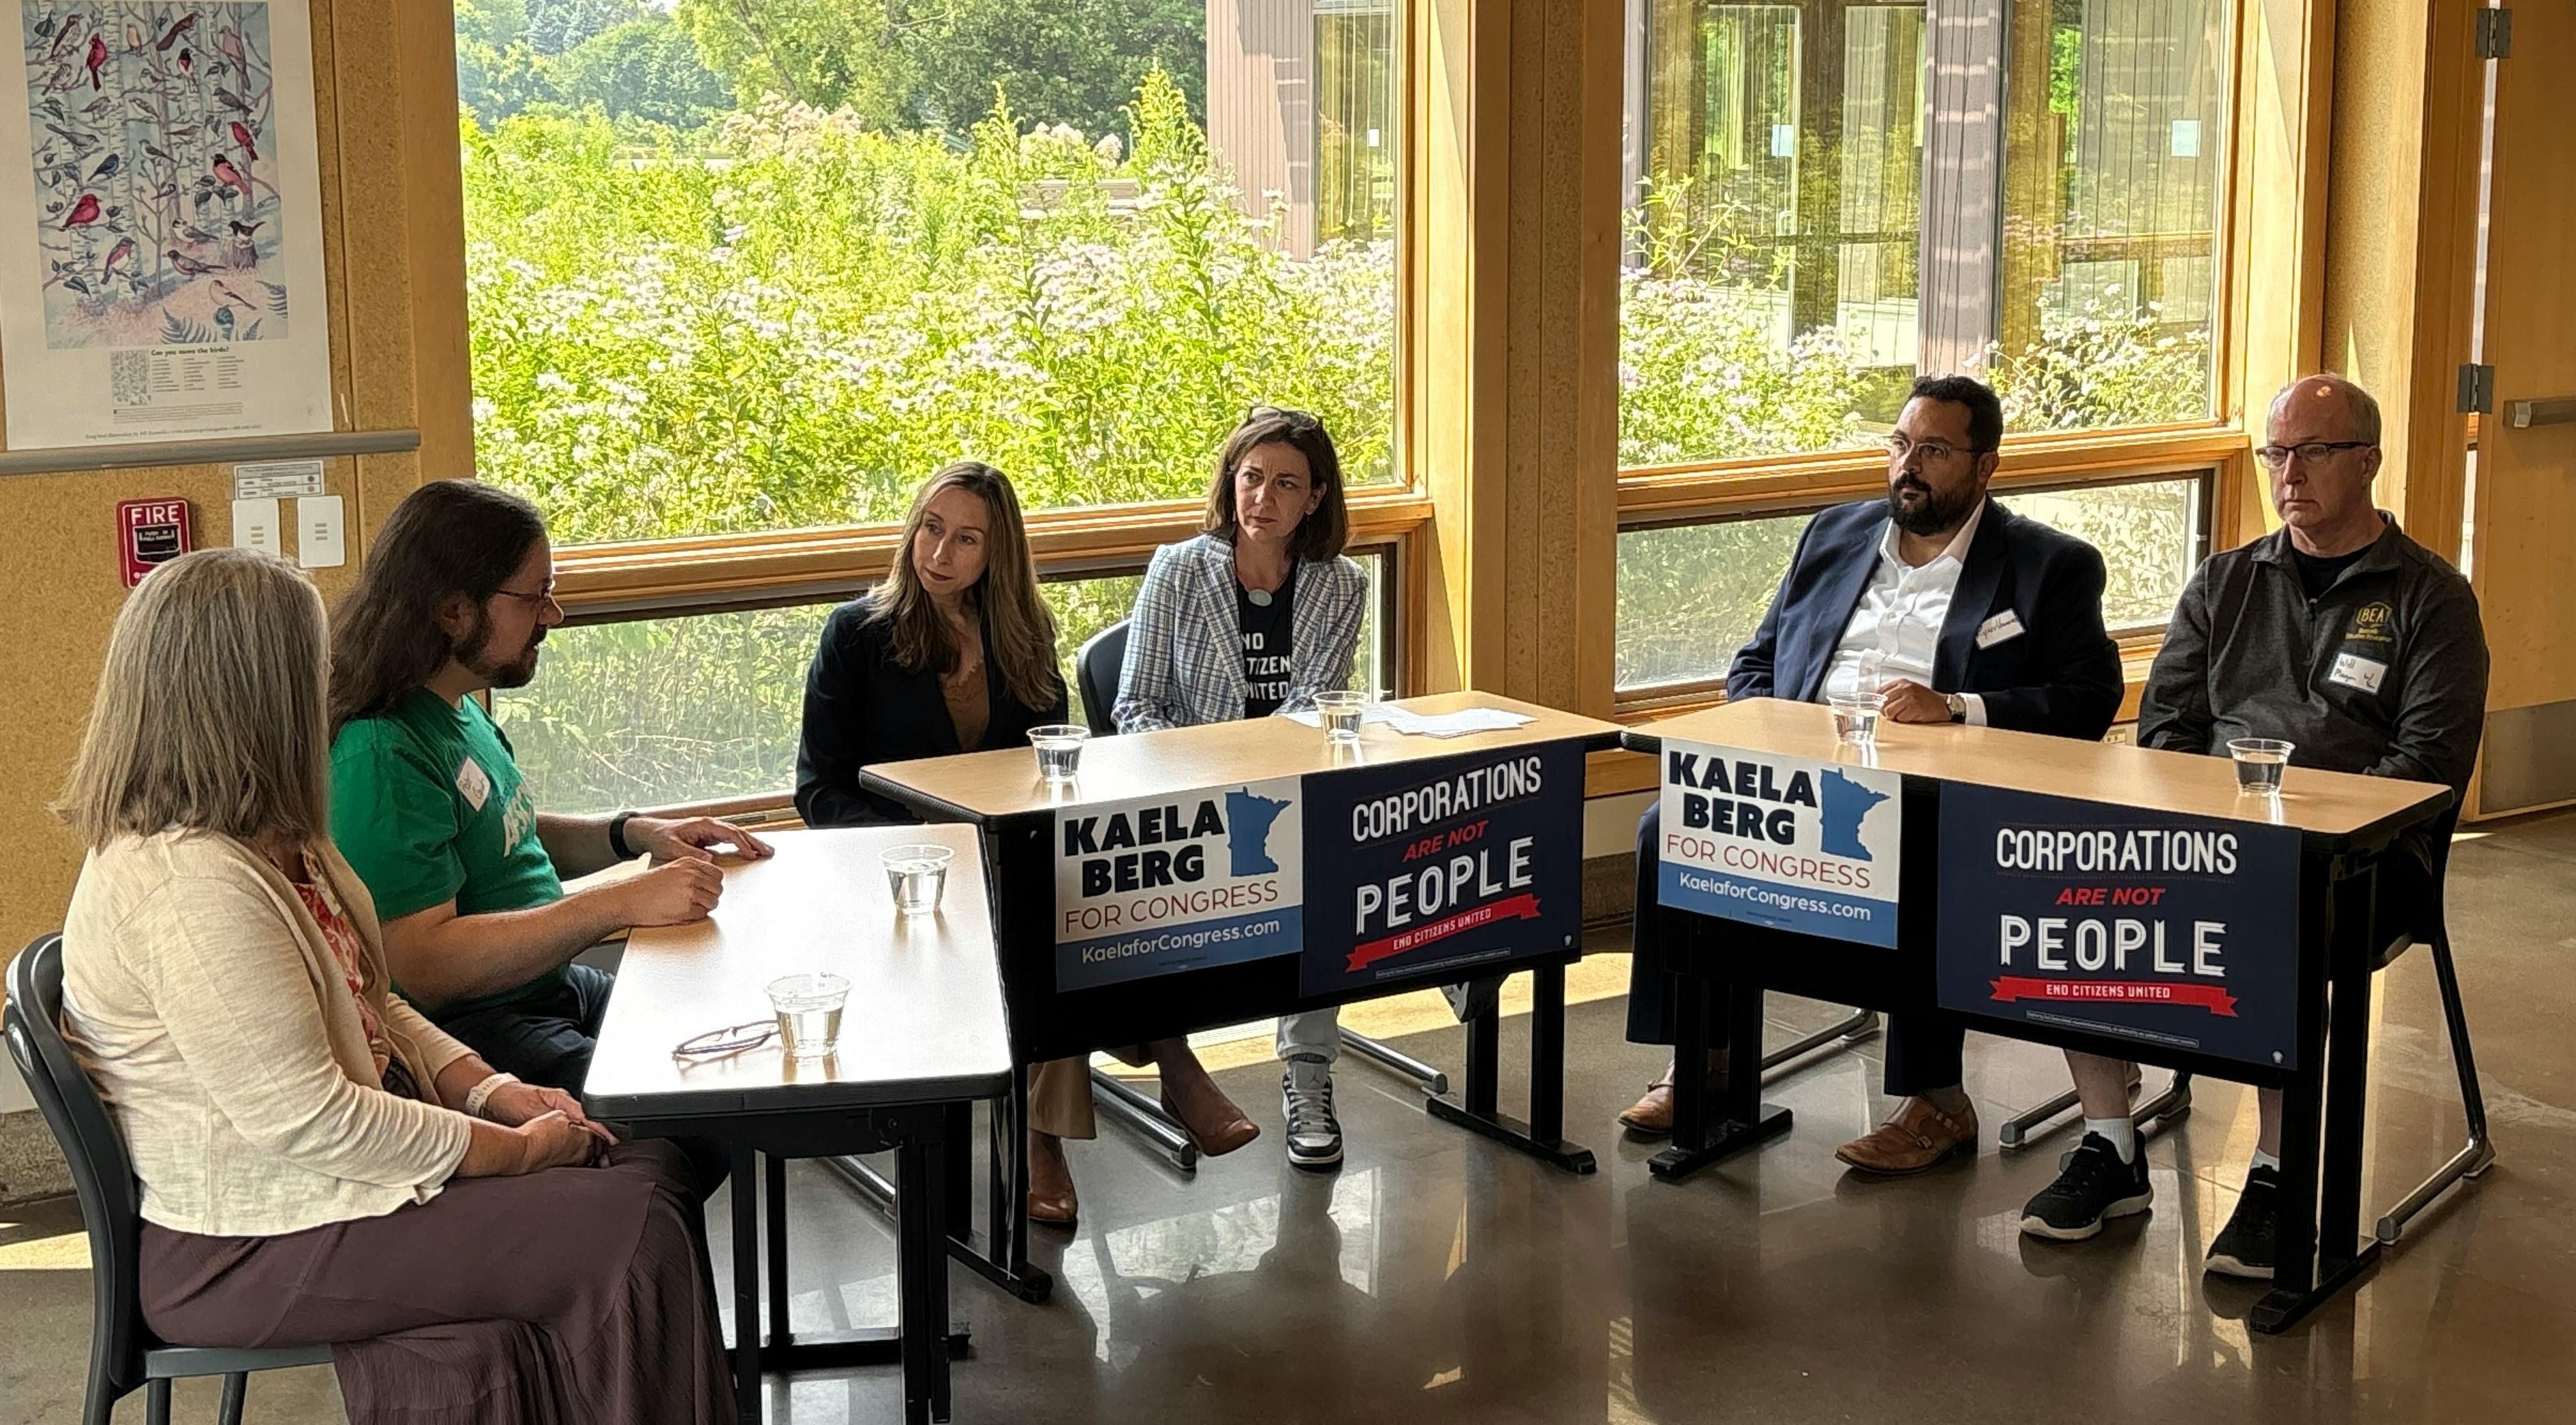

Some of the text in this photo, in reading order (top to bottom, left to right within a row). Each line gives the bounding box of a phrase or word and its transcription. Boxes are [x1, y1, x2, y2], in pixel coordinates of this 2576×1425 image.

[131, 505, 180, 525] FIRE
[2361, 607, 2384, 623] BEA
[1241, 632, 1264, 650] ND
[1246, 655, 1291, 675] TIZEN
[1246, 680, 1289, 701] NITED
[1352, 756, 1542, 842] CORPORATIONS
[1669, 751, 1818, 809] KAELA
[1064, 800, 1226, 857] KAELA
[1402, 819, 1489, 862] ARE NOT
[1683, 793, 1795, 846] BERG
[1082, 844, 1205, 899] BERG
[1666, 834, 1871, 889] FOR CONGRESS
[1997, 828, 2238, 875] CORPORATIONS
[1065, 880, 1278, 934] FOR CONGRESS
[1356, 835, 1534, 936] PEOPLE
[1679, 871, 1871, 922] KaelaforCongress.com
[2055, 887, 2166, 906] ARE NOT
[1082, 918, 1280, 964] KaelaforCongress.com
[1393, 908, 1492, 950] END CITIZENS UNITED
[2000, 914, 2227, 977] PEOPLE
[2046, 984, 2170, 998] END CITIZENS UNITED
